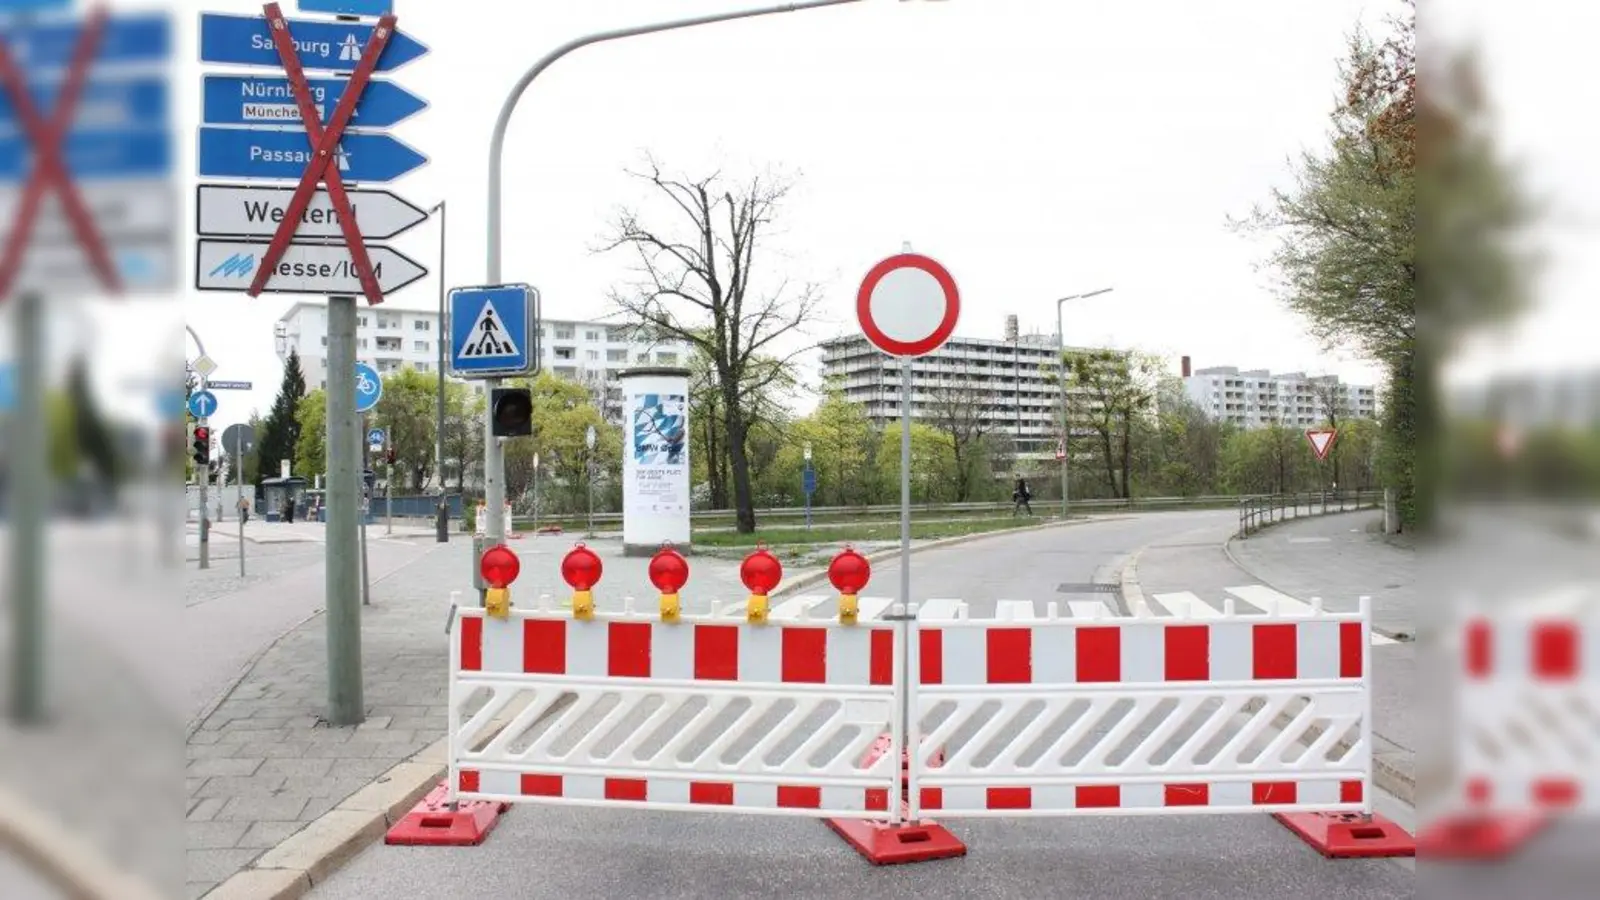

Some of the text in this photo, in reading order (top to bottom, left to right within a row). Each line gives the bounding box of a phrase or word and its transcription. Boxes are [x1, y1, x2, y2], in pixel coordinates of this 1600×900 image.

[251, 34, 330, 58] Saburg
[242, 82, 325, 102] Nürnbg
[245, 105, 304, 118] Münche
[244, 200, 357, 224] Weten
[261, 257, 382, 280] esse/IC
